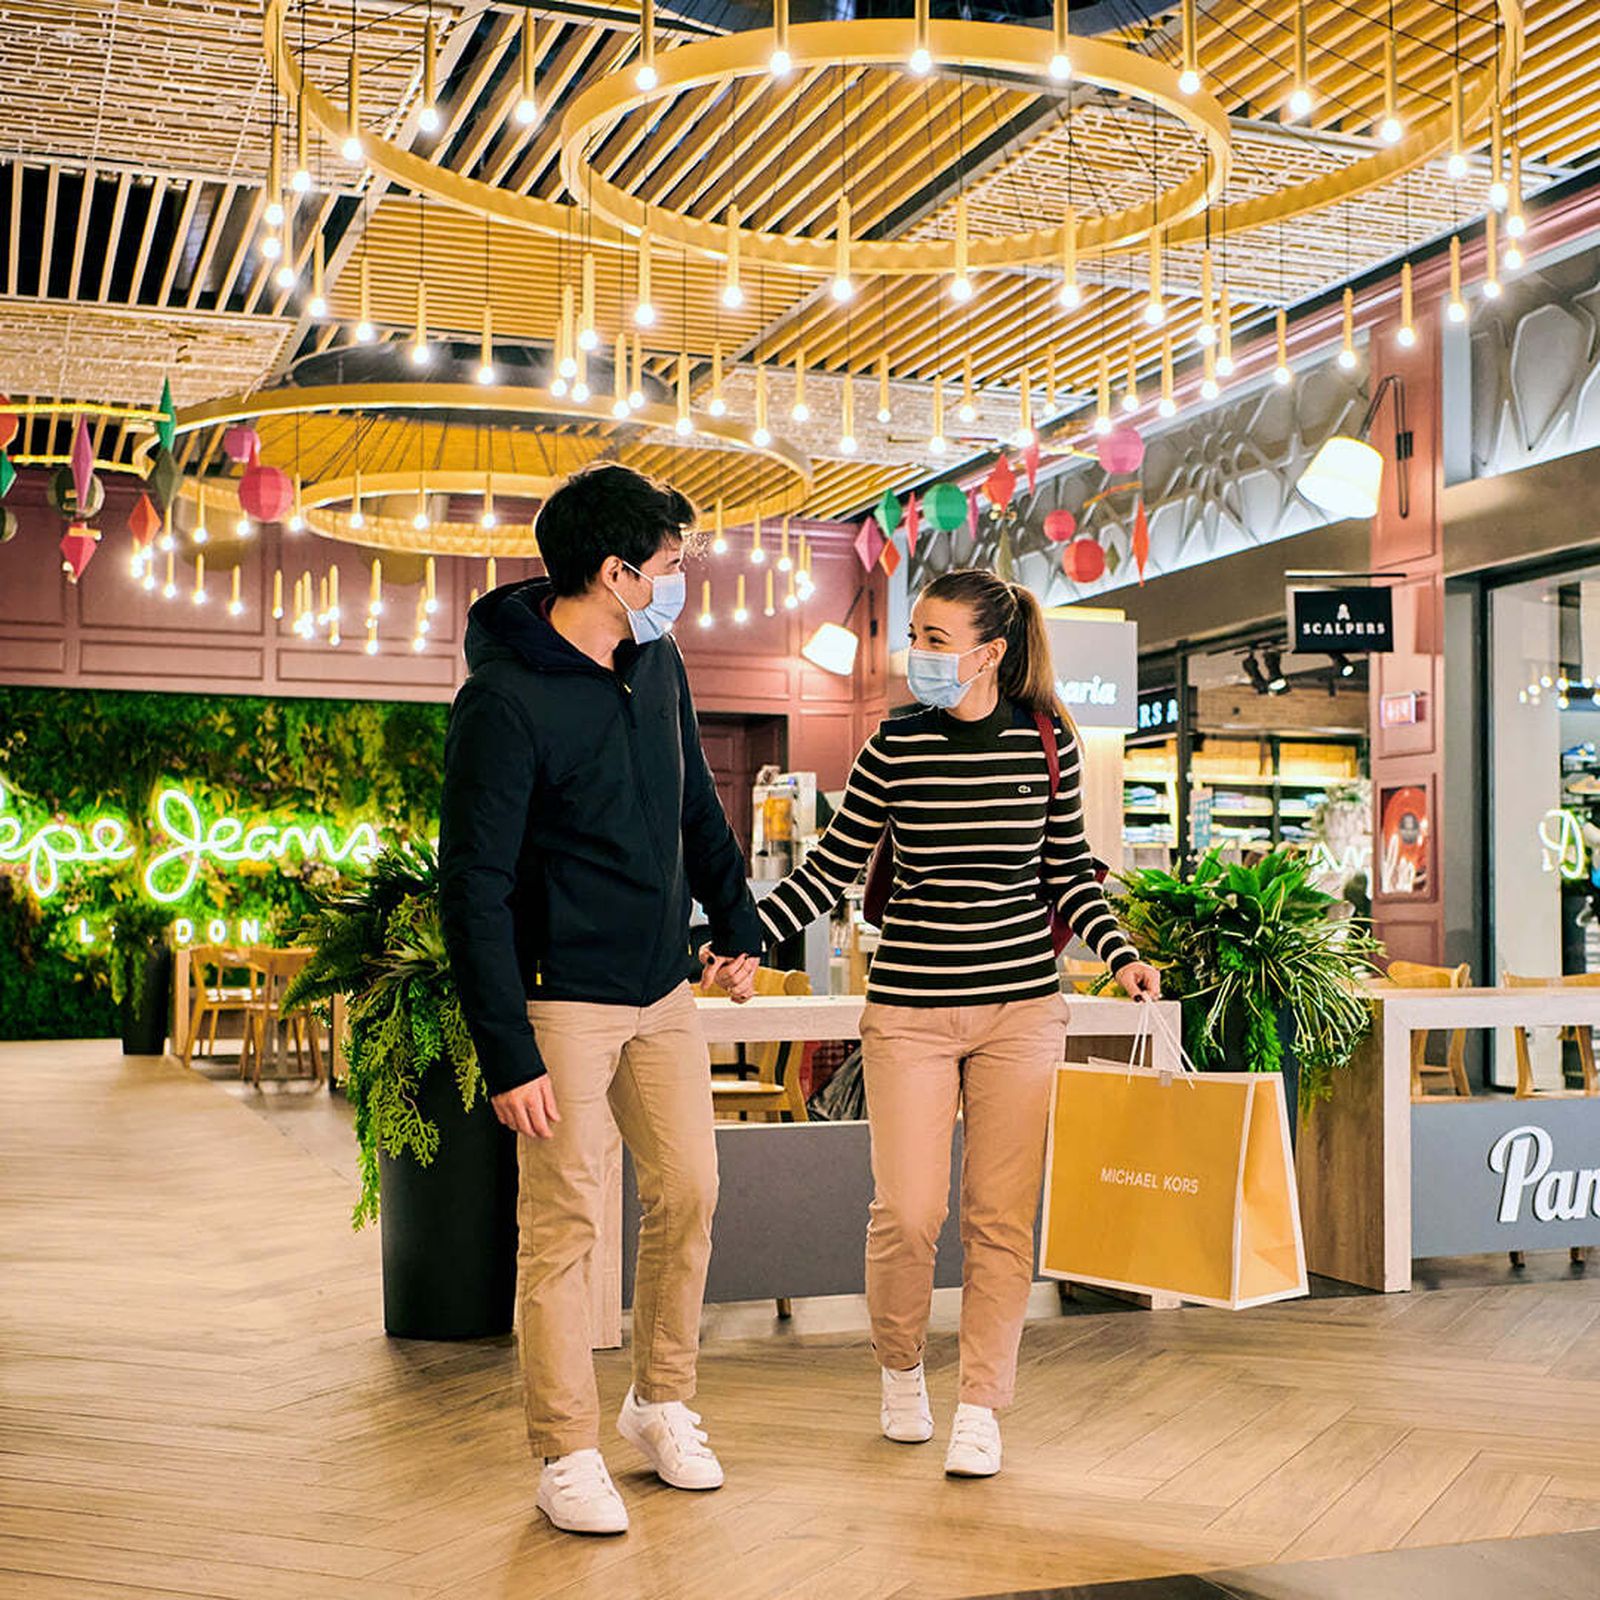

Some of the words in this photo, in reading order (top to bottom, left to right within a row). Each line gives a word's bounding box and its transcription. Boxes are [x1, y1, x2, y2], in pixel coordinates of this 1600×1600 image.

[1302, 622, 1386, 635] SCALPERS
[0, 783, 136, 899] epe
[144, 789, 380, 902] Jeans
[79, 917, 260, 944] LDON
[1100, 1167, 1159, 1189] MICHAEL
[1163, 1175, 1200, 1195] KORS
